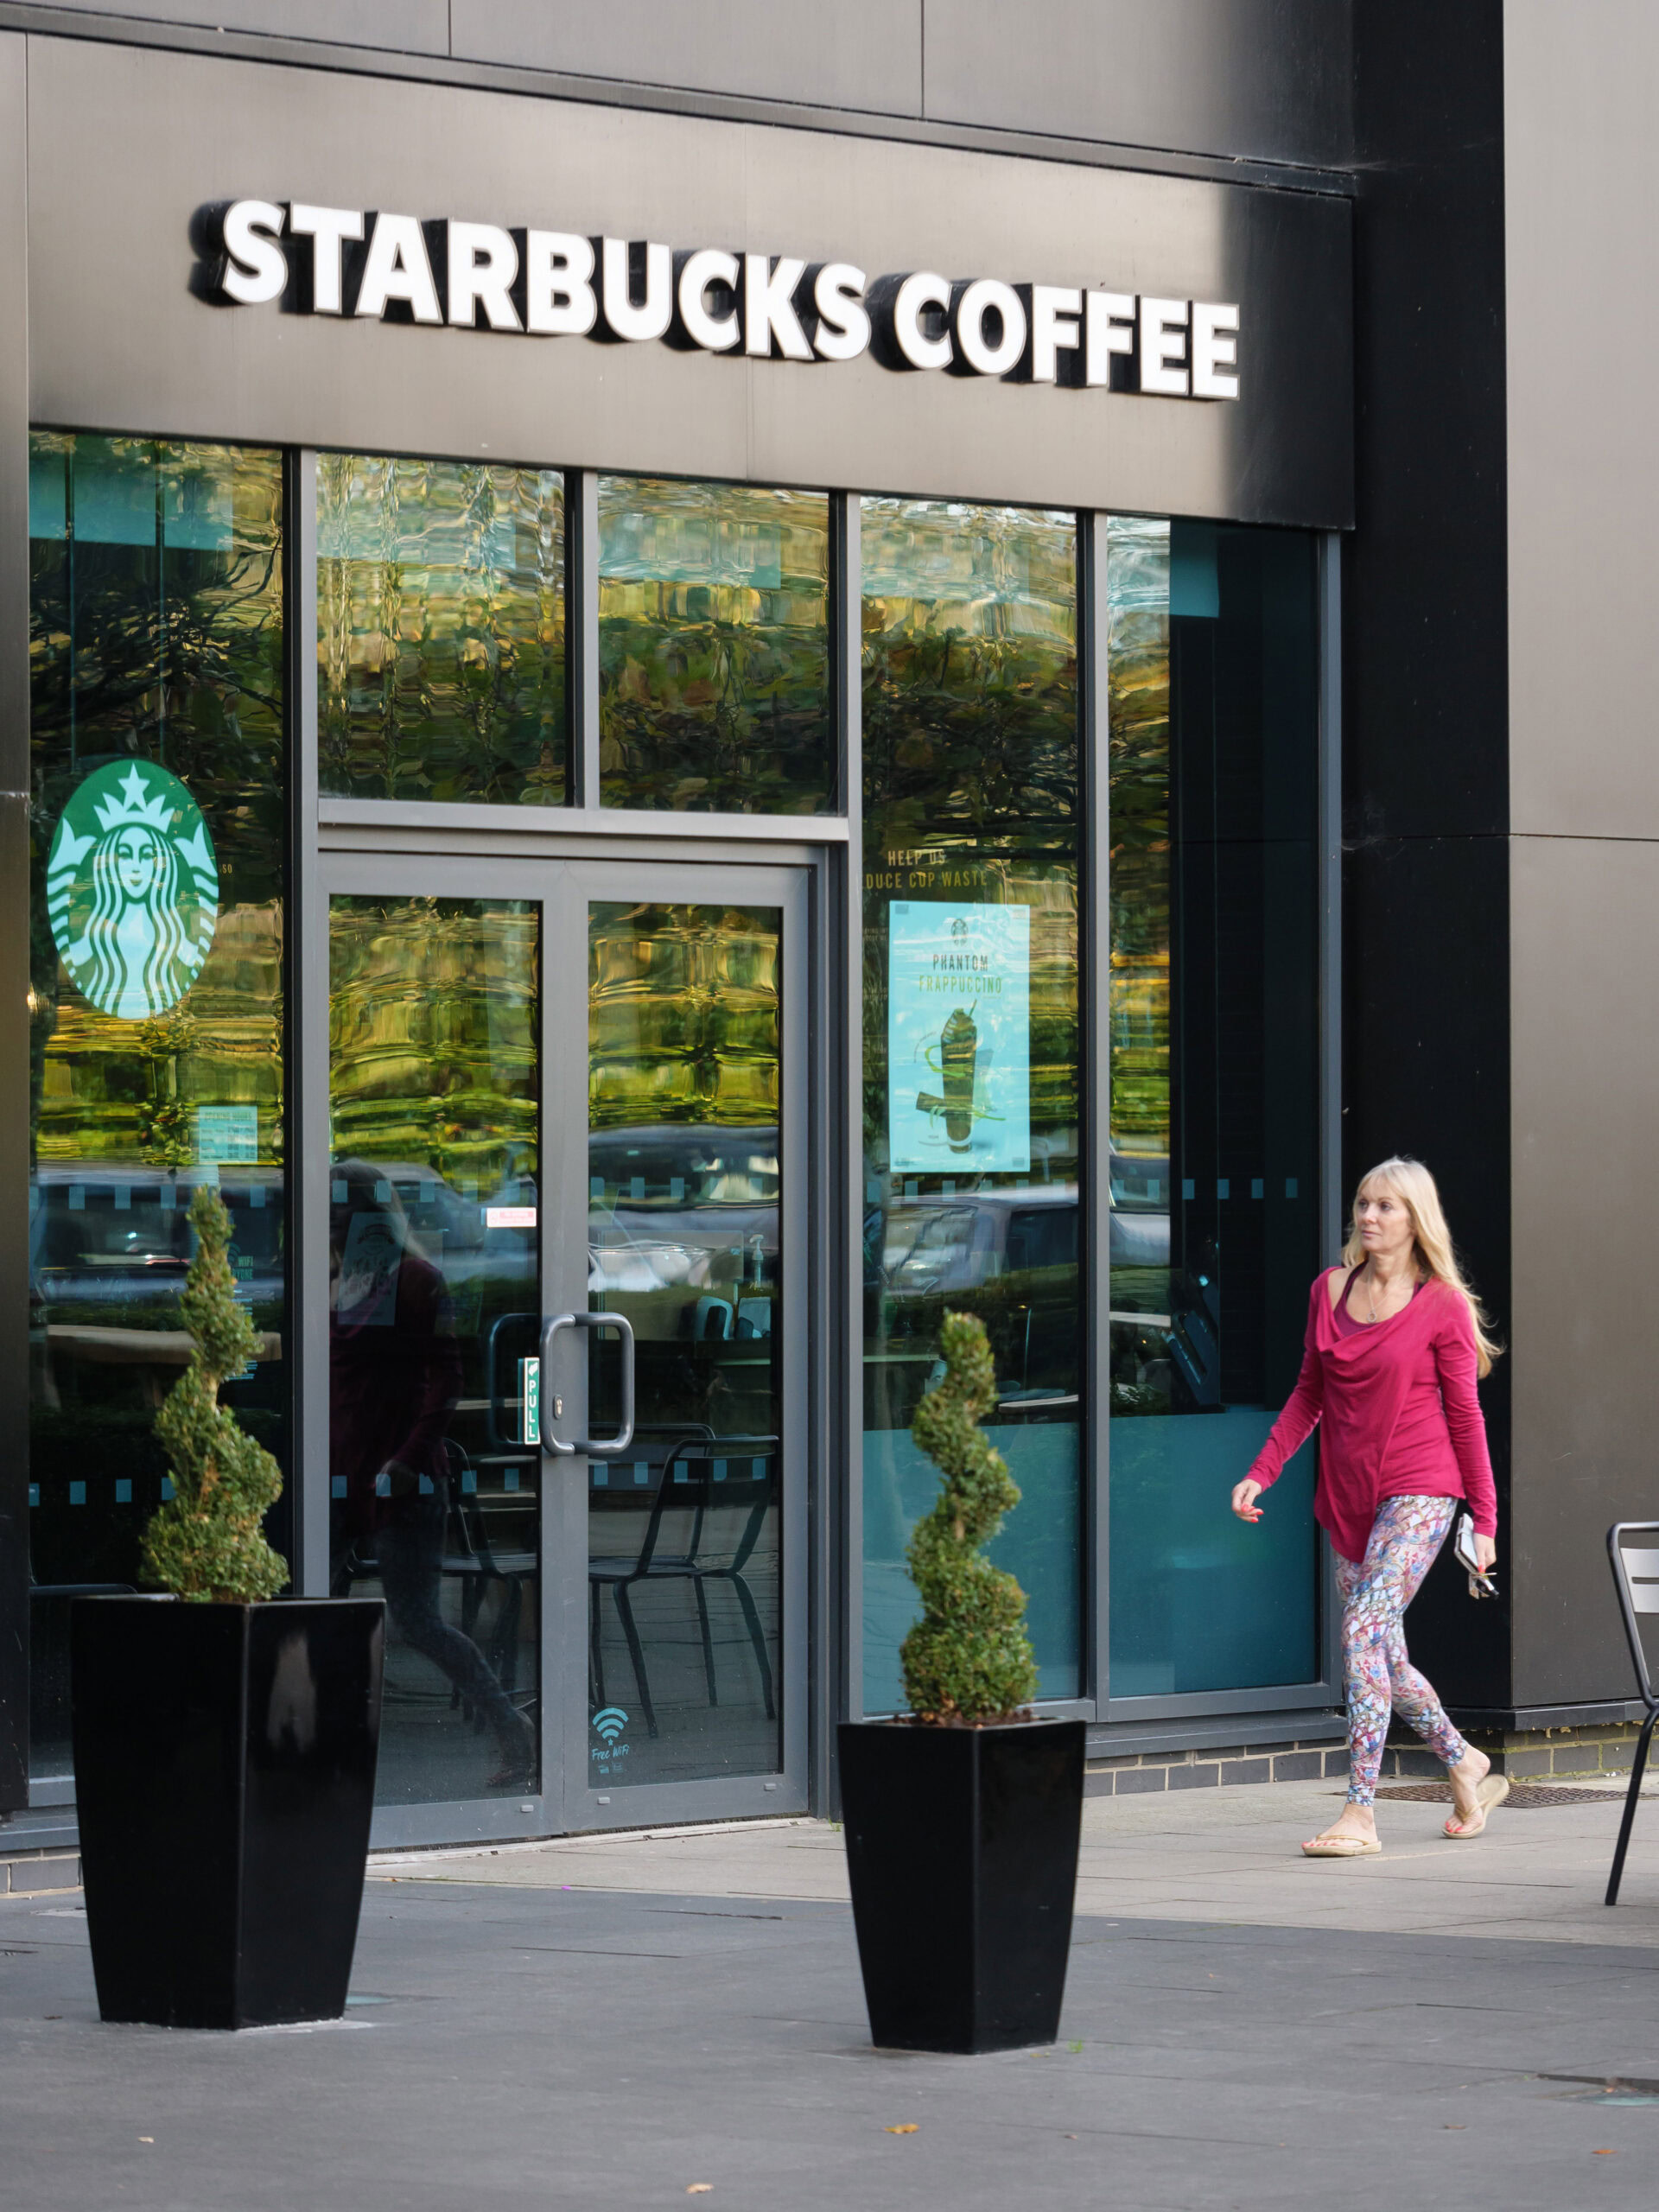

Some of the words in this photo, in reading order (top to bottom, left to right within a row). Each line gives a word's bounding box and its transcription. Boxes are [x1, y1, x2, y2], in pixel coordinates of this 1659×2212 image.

[222, 199, 871, 360] STARBUCKS
[894, 271, 1240, 400] COFFEE
[887, 850, 922, 867] HELP
[909, 871, 935, 888] CUP
[941, 870, 988, 887] WASTE
[932, 953, 988, 971] PHANTOM
[918, 974, 1002, 994] FRAPPUCCINO
[529, 1379, 537, 1439] PULL
[591, 1748, 611, 1760] Free
